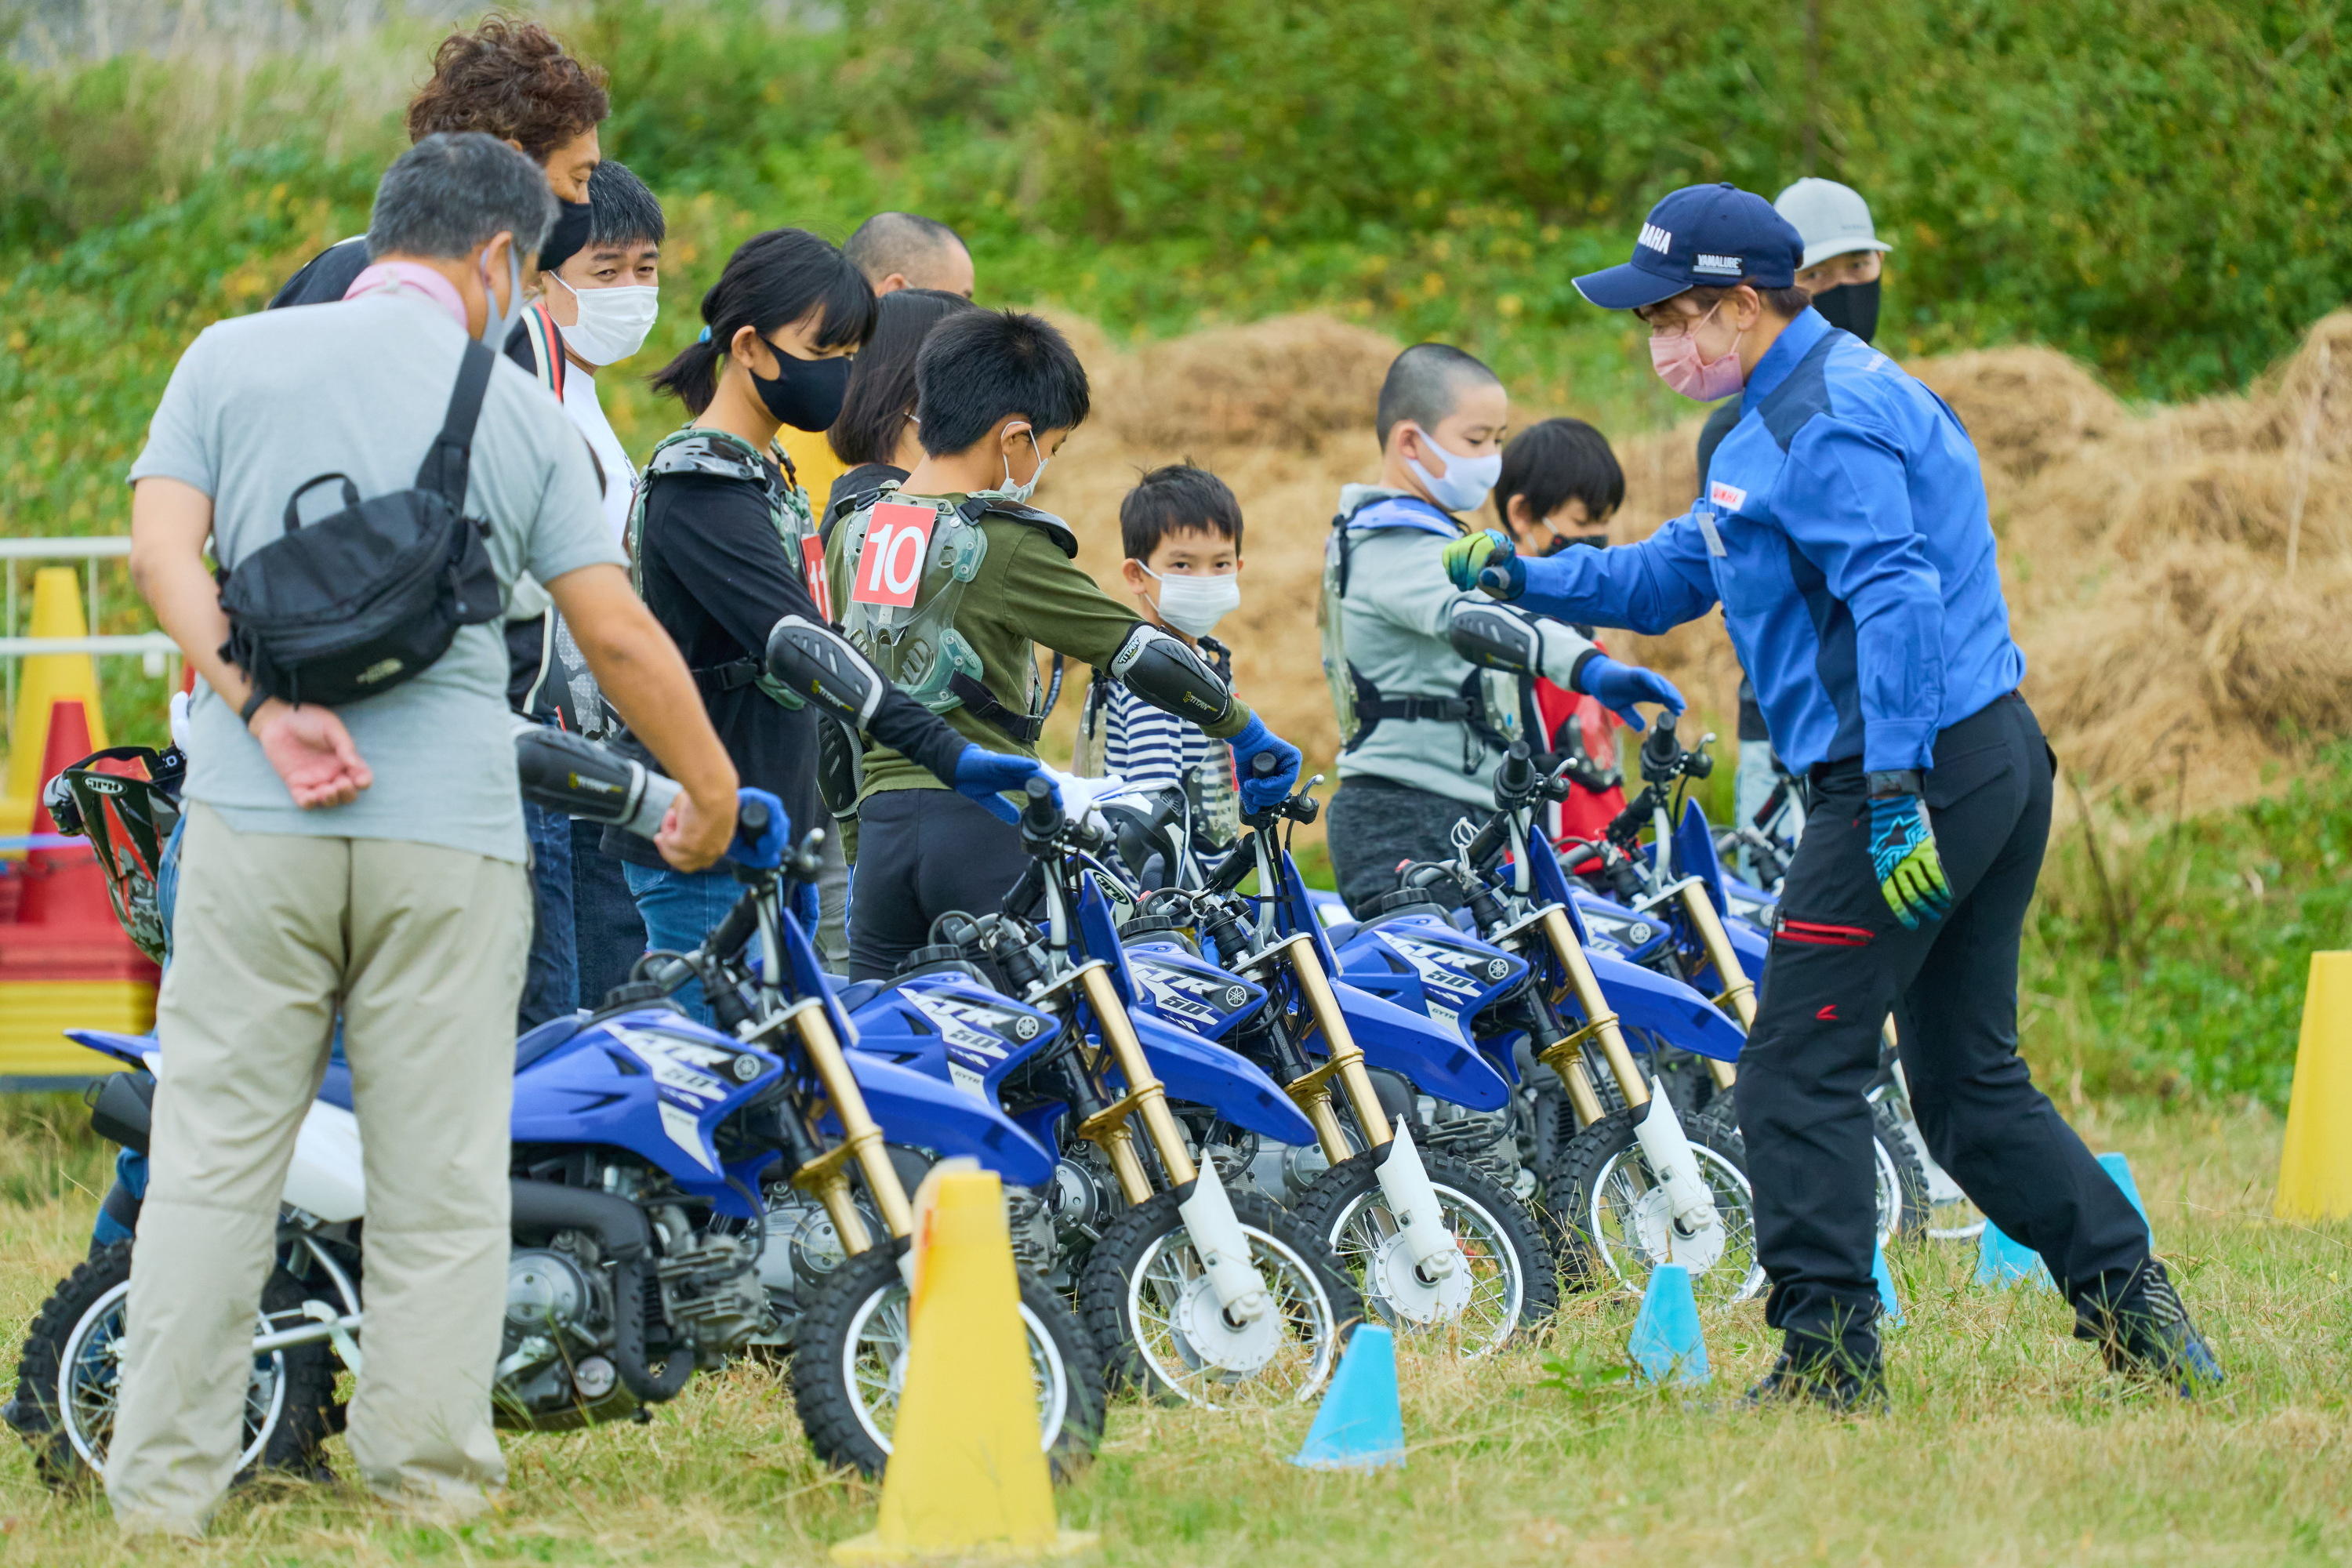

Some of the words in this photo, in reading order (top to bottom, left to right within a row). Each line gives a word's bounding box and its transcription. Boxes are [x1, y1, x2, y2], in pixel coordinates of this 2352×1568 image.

[869, 524, 926, 594] 10
[810, 557, 837, 627] 11
[1118, 636, 1139, 663] TITAN
[1190, 695, 1210, 710] TITAN
[1390, 938, 1489, 969] TTR
[1426, 970, 1472, 989] 50
[1161, 996, 1209, 1016] 50
[1432, 1008, 1456, 1019] GYTR
[949, 1029, 998, 1049] 50
